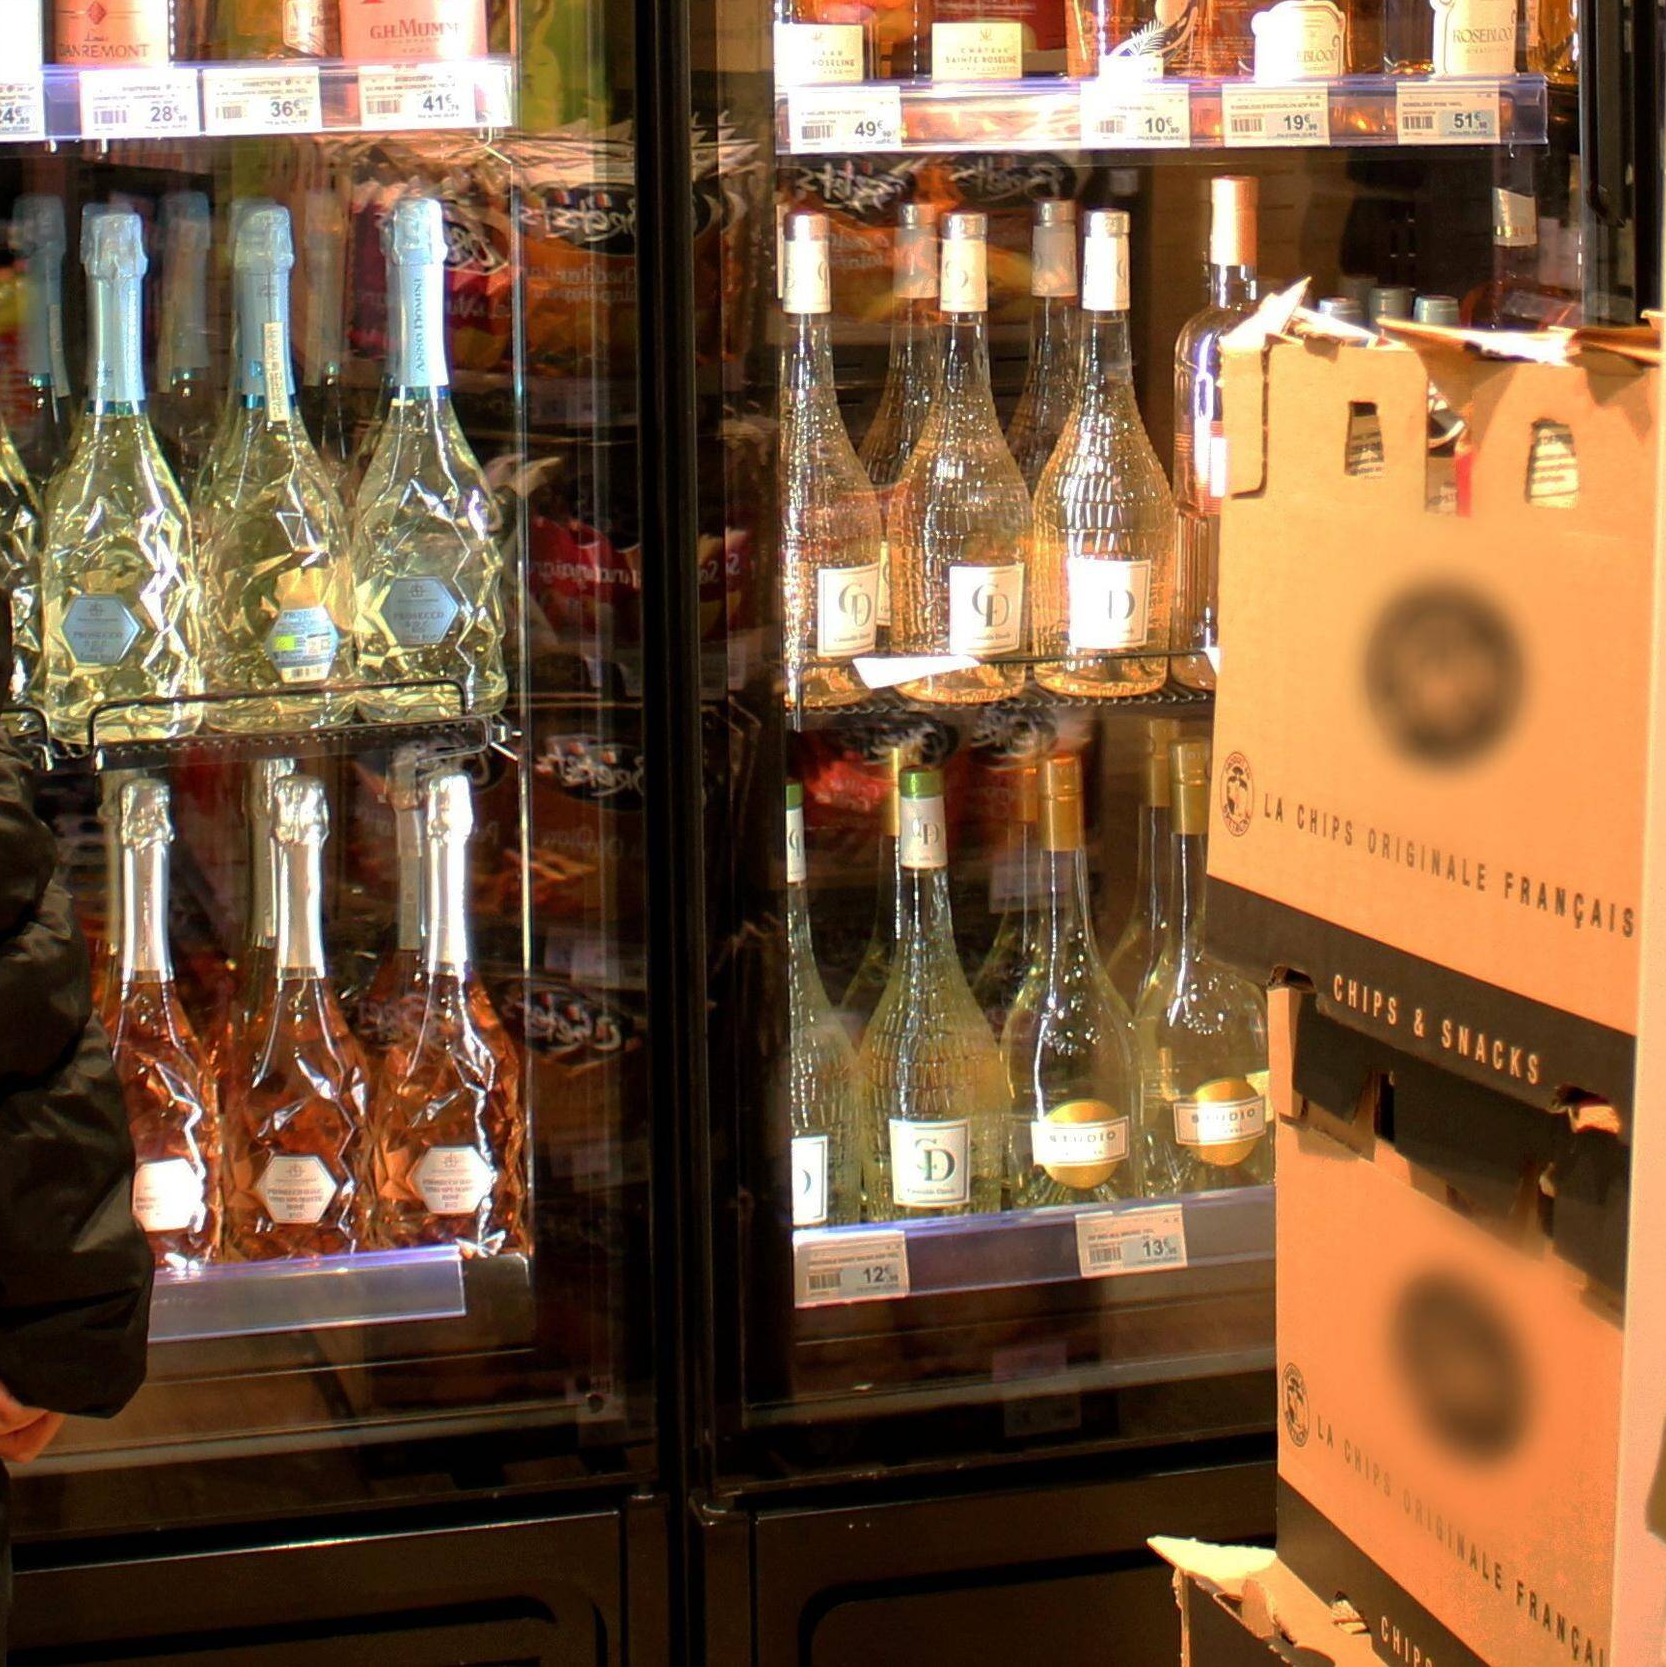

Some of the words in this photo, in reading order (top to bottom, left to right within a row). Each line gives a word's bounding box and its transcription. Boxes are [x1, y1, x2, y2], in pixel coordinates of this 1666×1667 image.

[58, 43, 150, 59] DANREMONT
[944, 55, 980, 66] SAINTE
[981, 55, 1018, 65] ROSELINE
[1263, 792, 1285, 823] LA
[1296, 803, 1355, 847] CHIPS
[1366, 827, 1487, 892] ORIGINALE
[1503, 871, 1635, 938] FRANÇAIS
[1333, 973, 1399, 1026] CHIPS
[1412, 1008, 1426, 1039] &
[1440, 1019, 1541, 1086] SNACKS
[1316, 1414, 1334, 1449] LA
[1343, 1439, 1392, 1497] CHIPS
[1402, 1487, 1504, 1591] ORIGINALE
